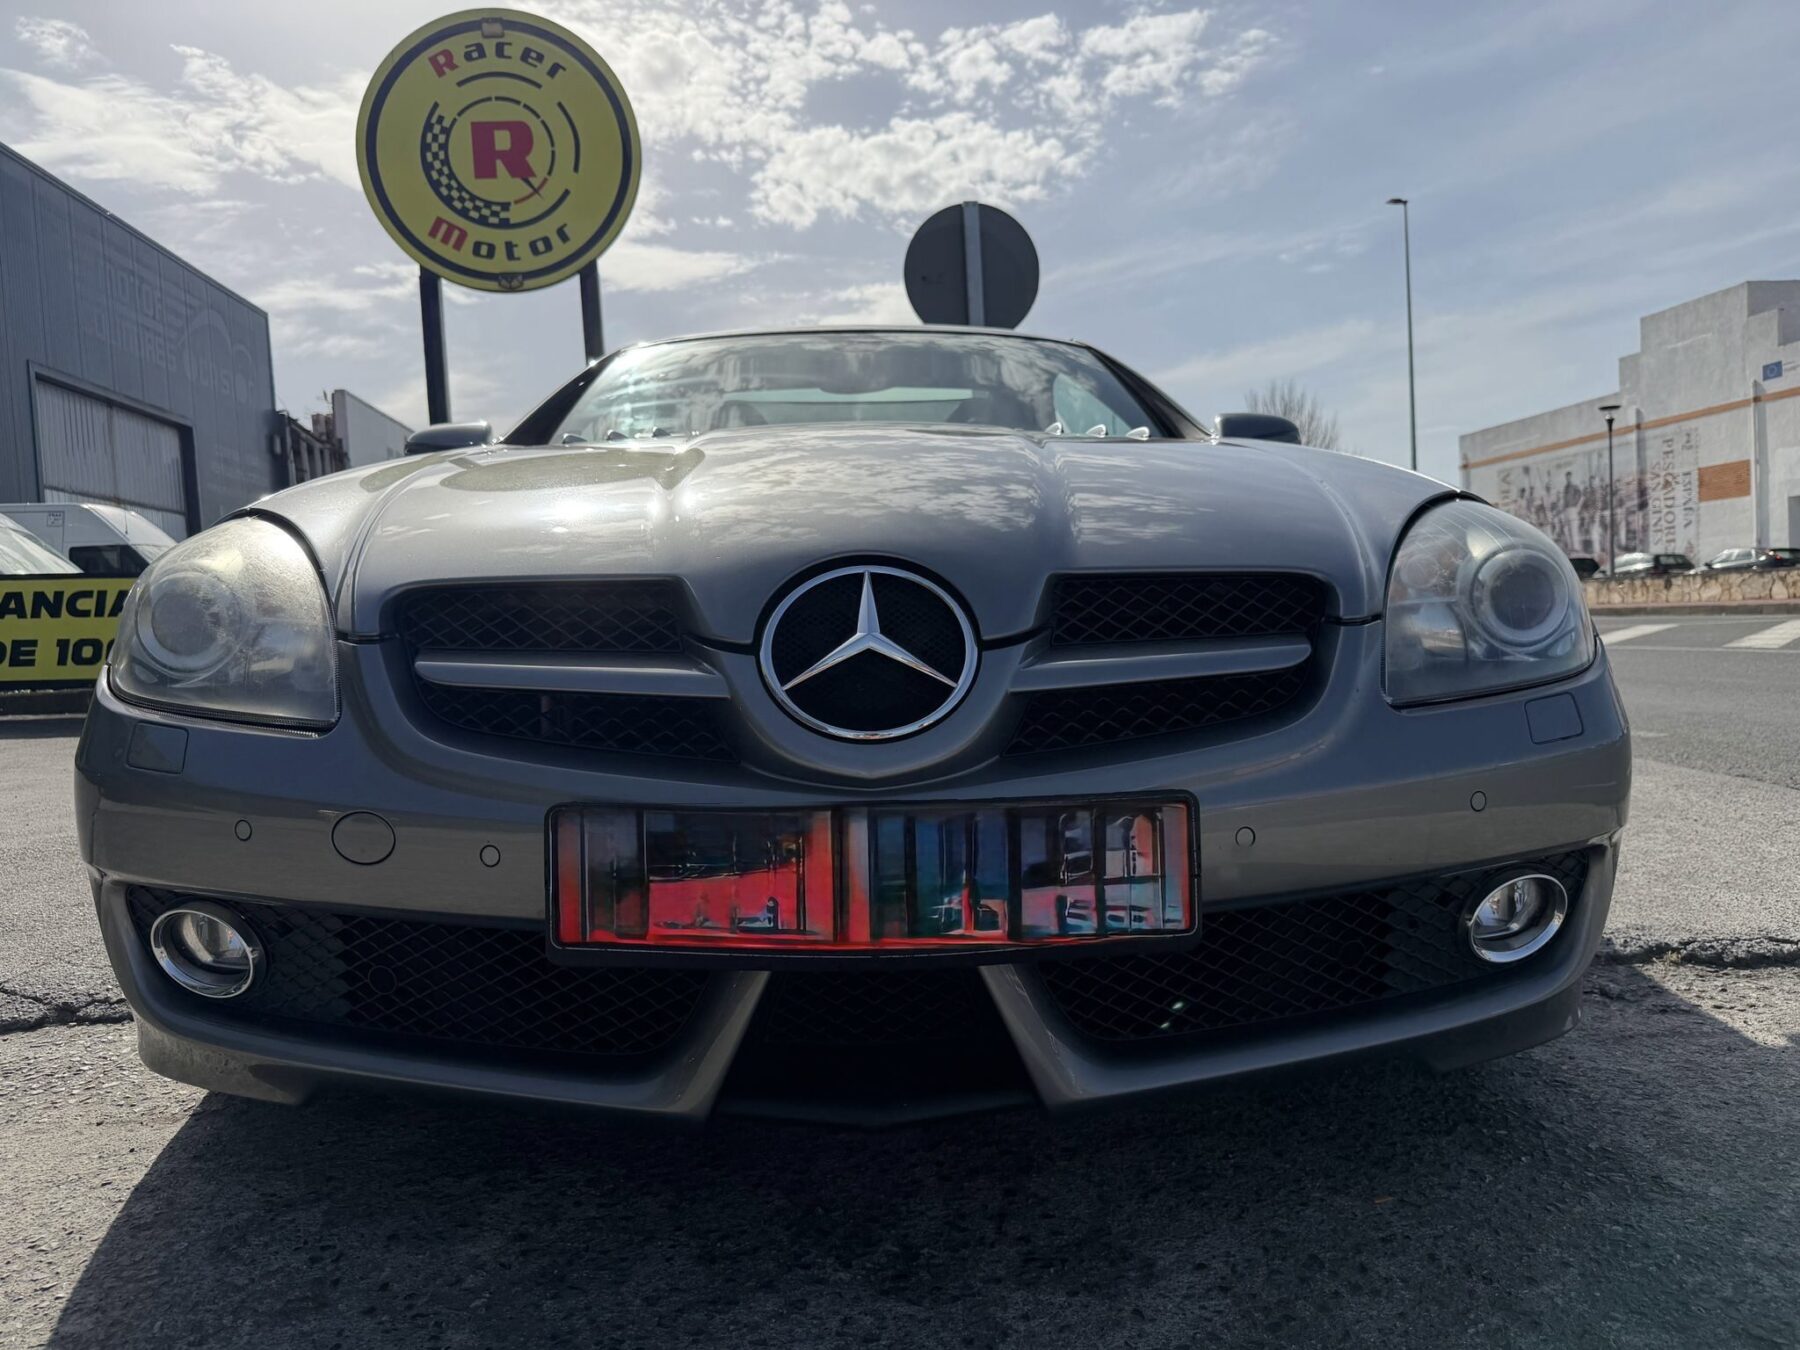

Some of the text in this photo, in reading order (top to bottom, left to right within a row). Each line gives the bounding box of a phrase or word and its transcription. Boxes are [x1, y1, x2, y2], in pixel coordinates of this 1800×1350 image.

[427, 41, 567, 79] Racer
[470, 120, 537, 180] R
[0, 639, 38, 667] E
